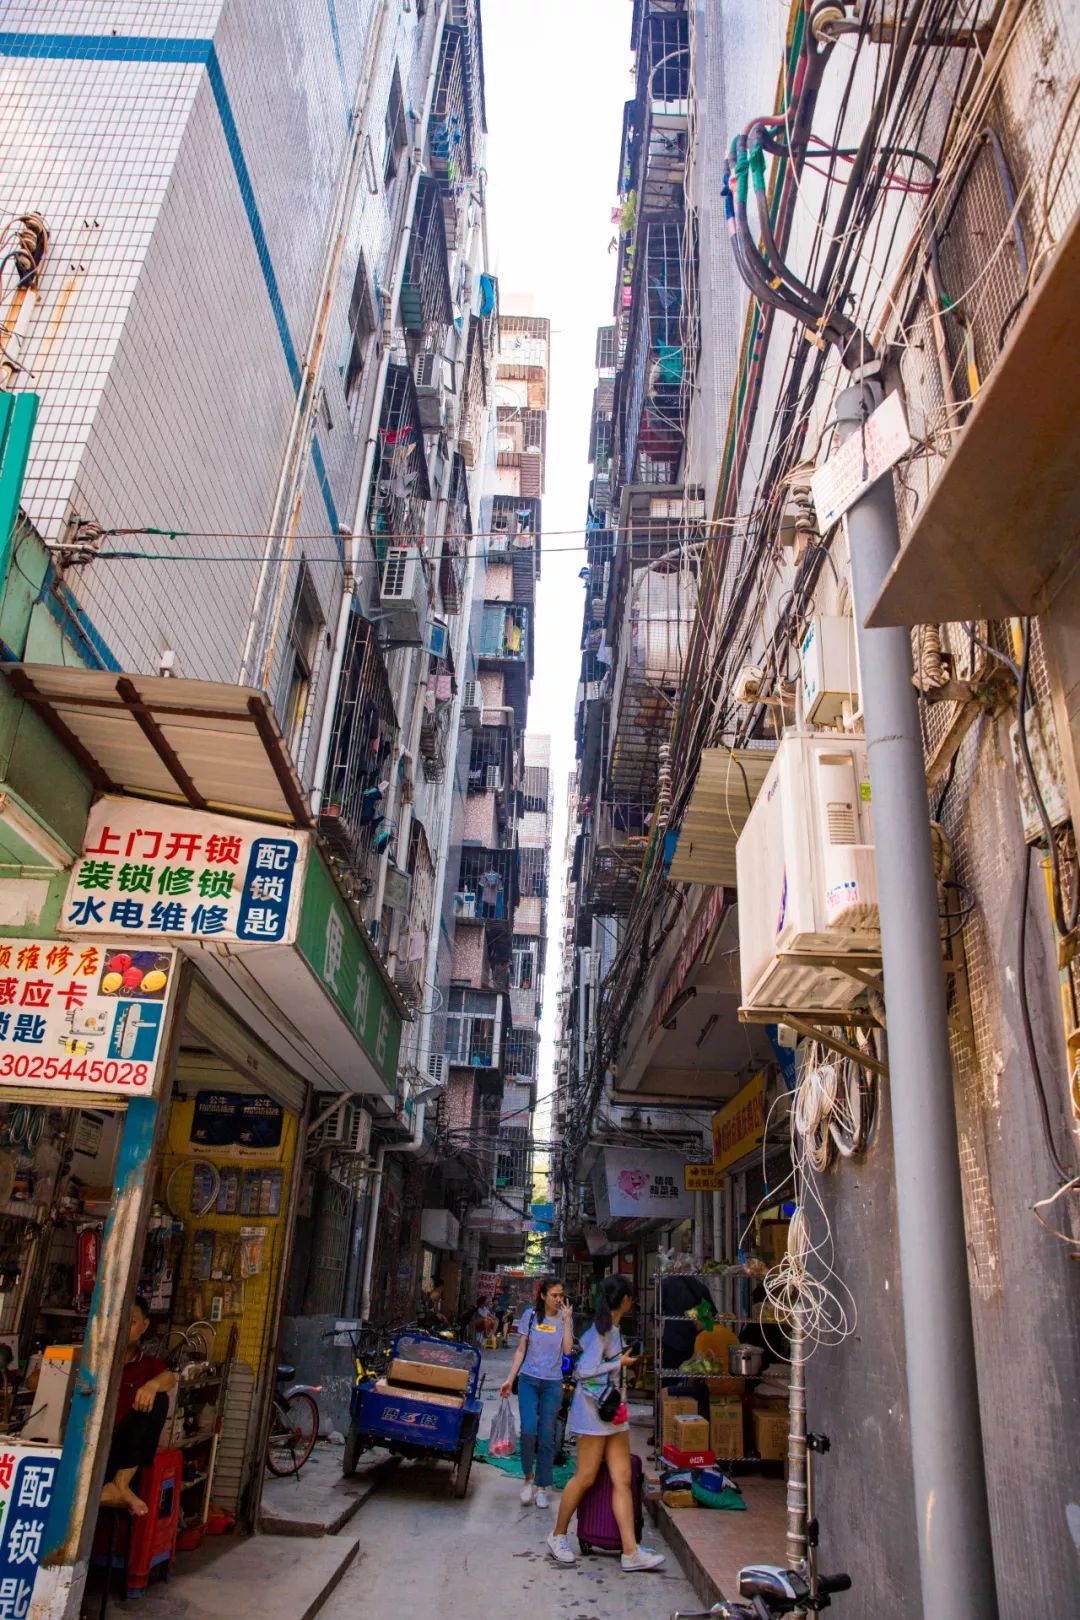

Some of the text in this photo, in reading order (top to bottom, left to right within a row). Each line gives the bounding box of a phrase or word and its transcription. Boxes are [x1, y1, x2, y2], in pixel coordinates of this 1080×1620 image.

[85, 826, 243, 865] 上门开锁
[77, 860, 236, 900] 装锁修锁
[243, 843, 291, 937] 配锁匙
[68, 896, 229, 935] 水电维修
[0, 1054, 149, 1086] 3025445028
[0, 1465, 55, 1620] 配锁匙
